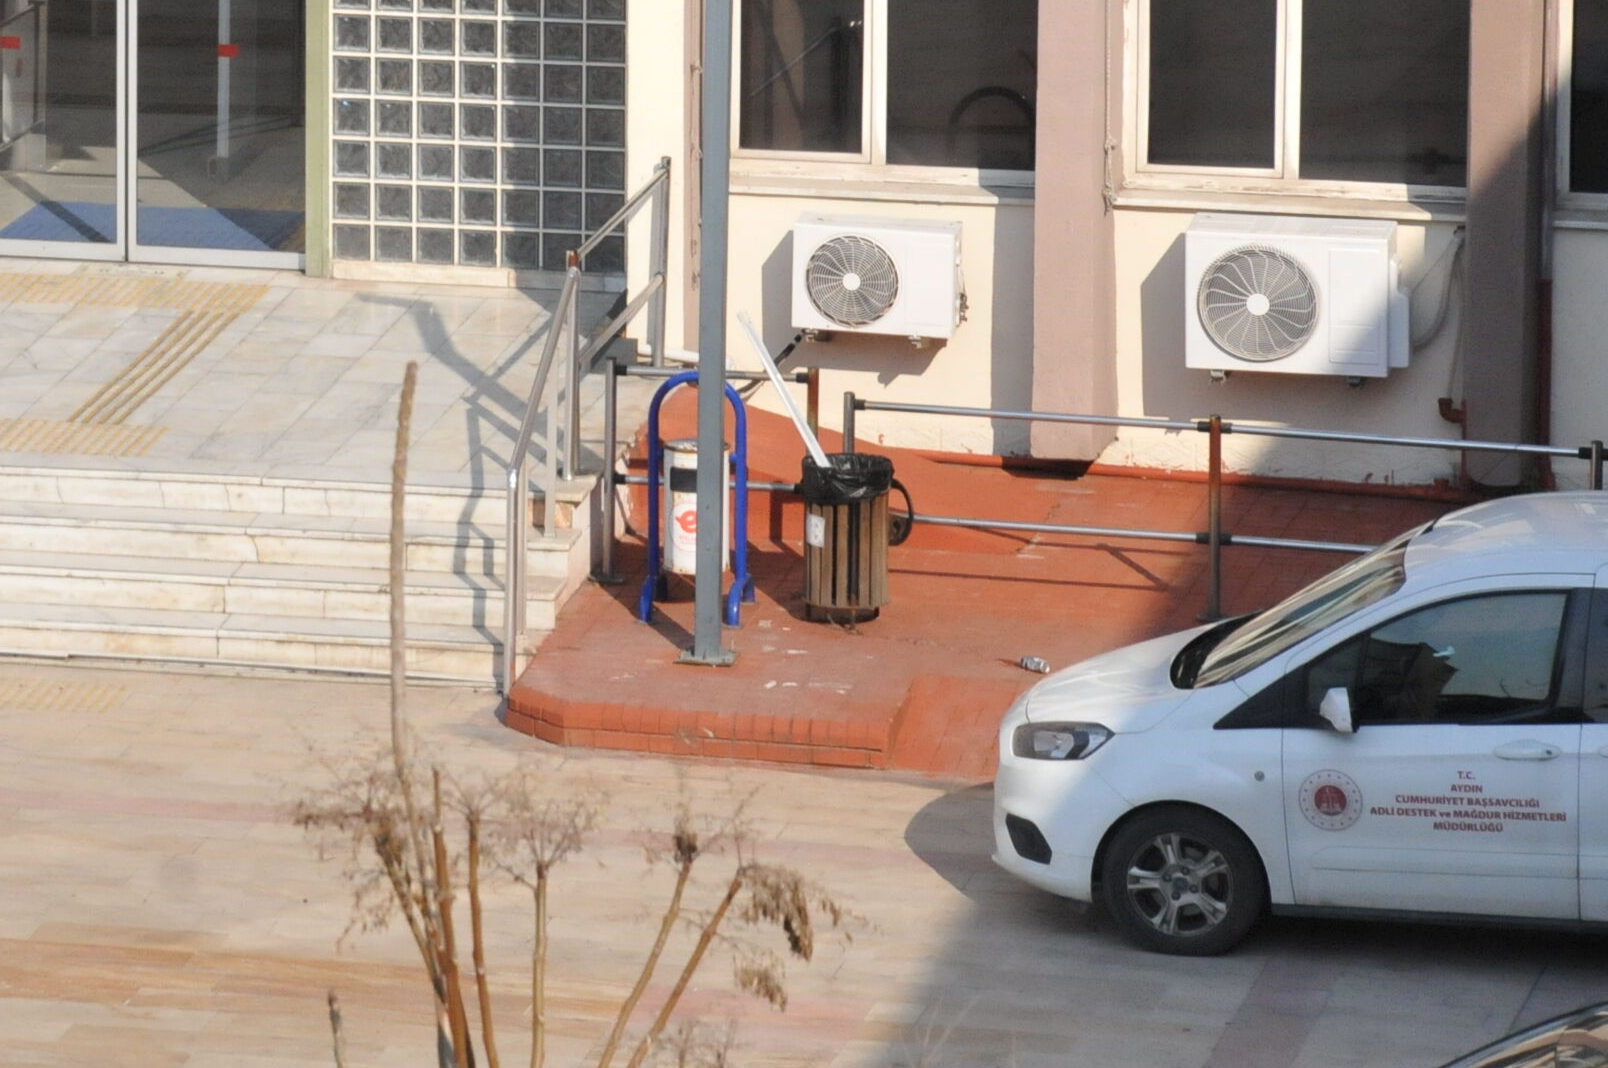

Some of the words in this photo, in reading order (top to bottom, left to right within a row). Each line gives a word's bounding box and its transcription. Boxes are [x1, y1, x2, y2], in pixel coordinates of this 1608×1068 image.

[1457, 770, 1476, 780] T.C.
[1450, 784, 1483, 793] AYDIN
[1395, 794, 1464, 805] CUMHURİYET
[1370, 806, 1394, 816] ADLİ
[1397, 808, 1437, 817] DESTEK
[1453, 809, 1502, 820] MAĞDUR
